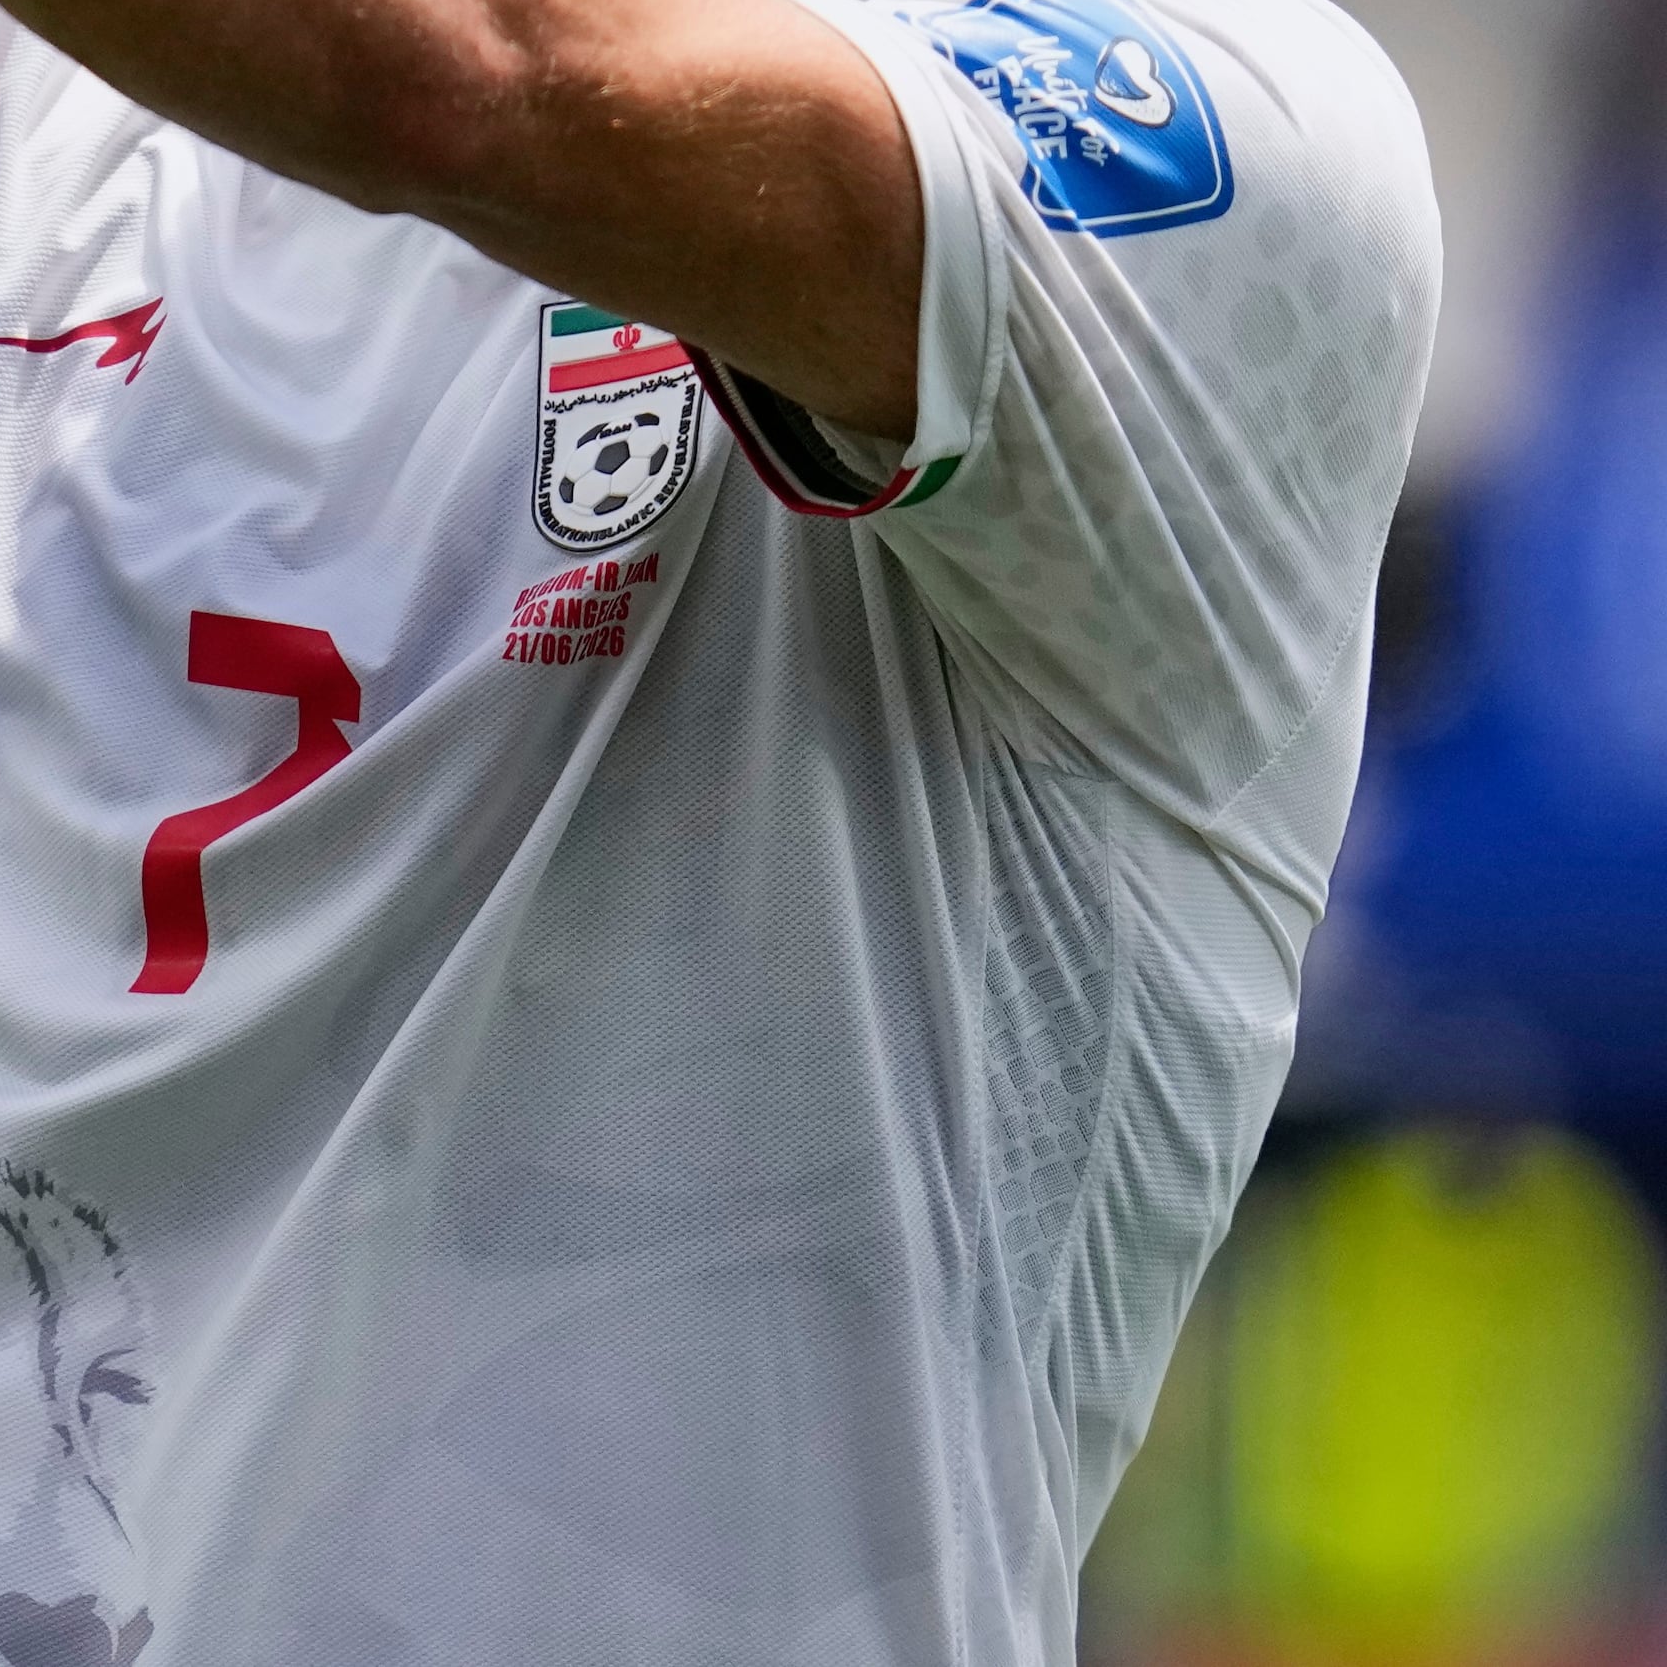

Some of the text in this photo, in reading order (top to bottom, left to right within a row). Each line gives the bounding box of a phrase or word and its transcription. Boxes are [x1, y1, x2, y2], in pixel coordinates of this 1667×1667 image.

[510, 591, 632, 630] LOS ANGELES
[502, 625, 626, 666] 21/06/2026
[128, 610, 361, 994] 7
